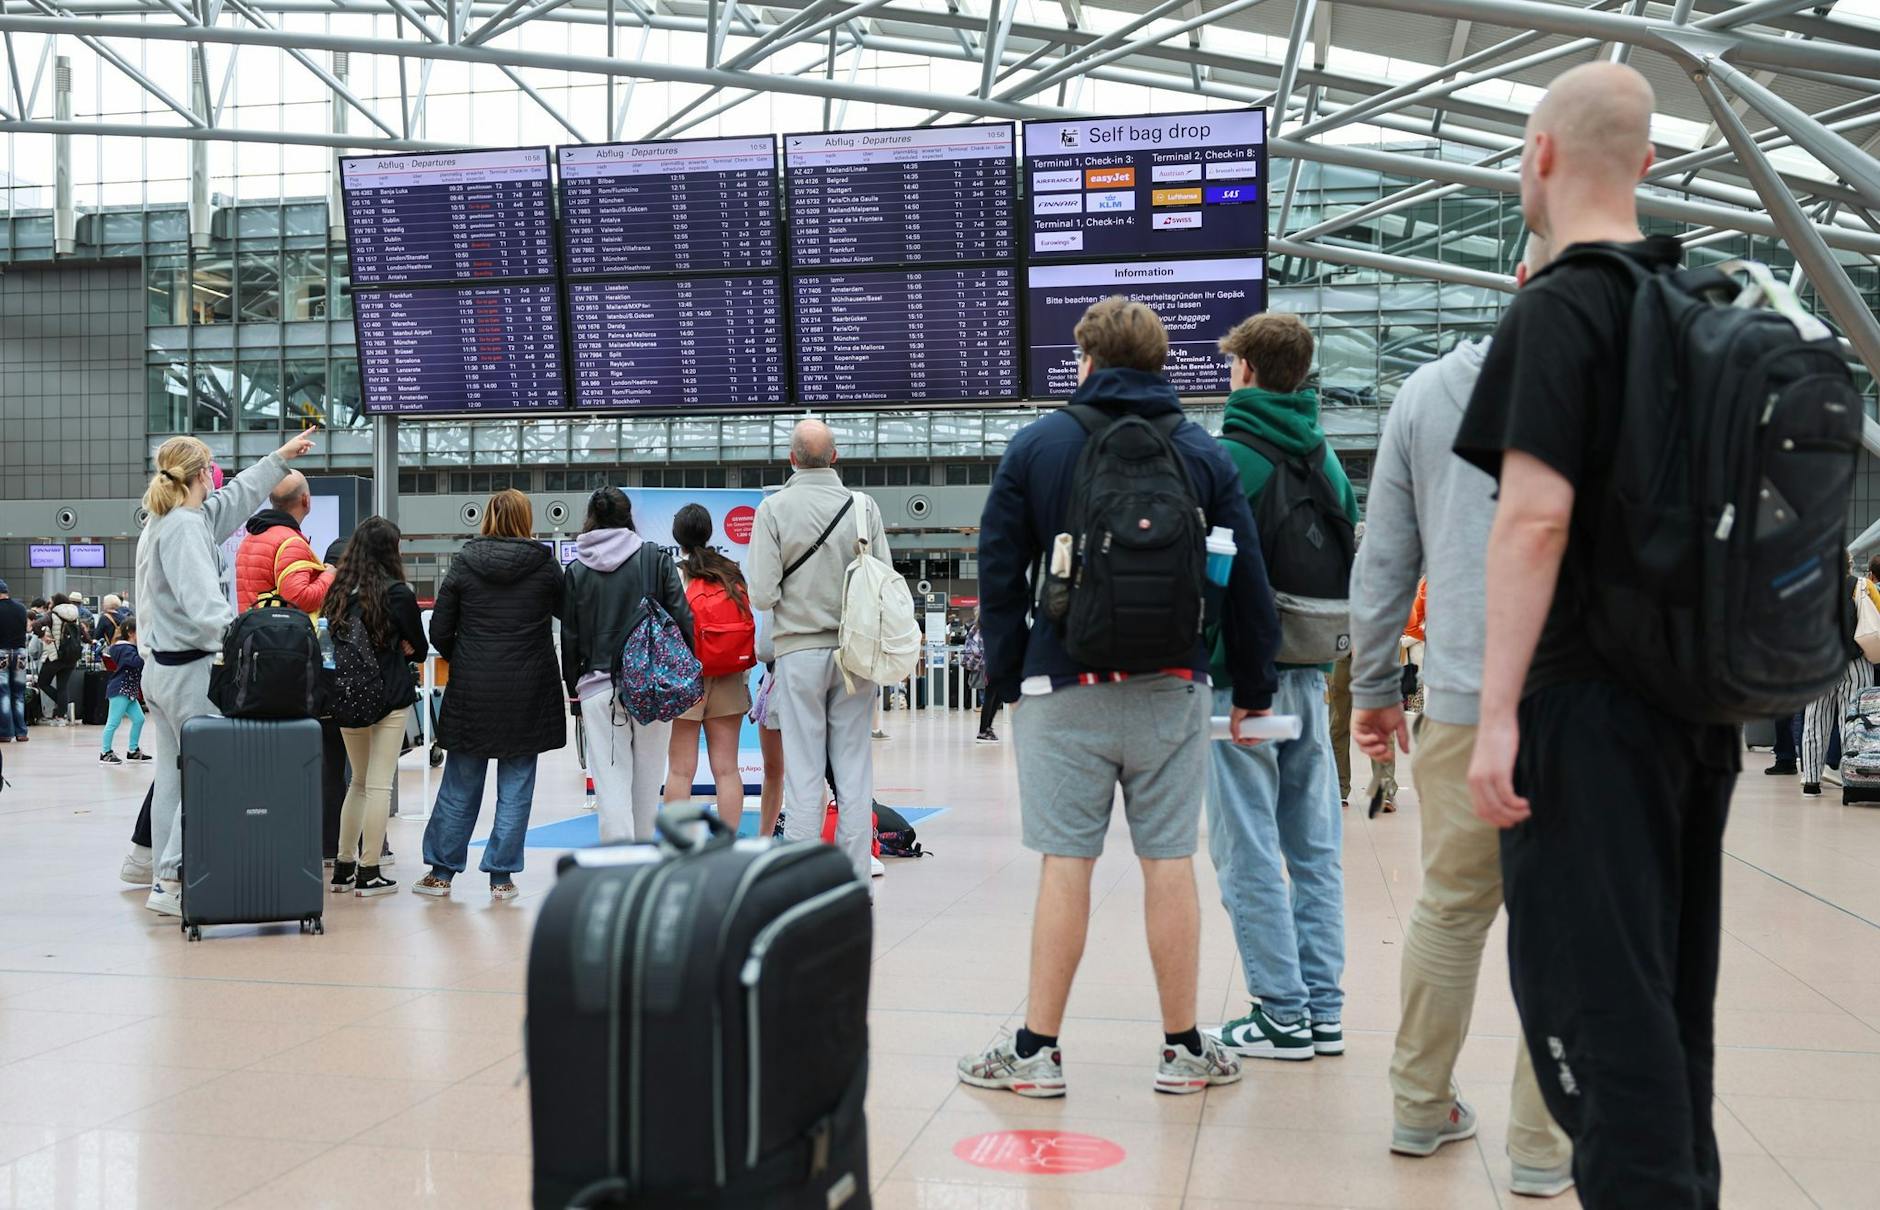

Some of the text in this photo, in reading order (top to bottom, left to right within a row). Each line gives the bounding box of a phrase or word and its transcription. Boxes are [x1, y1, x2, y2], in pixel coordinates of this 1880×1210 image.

[1089, 123, 1210, 143] Self bag drop
[825, 136, 912, 147] Abflug Departures
[596, 148, 678, 159] Abflug Departures
[1152, 148, 1255, 162] Terminal 2, Check-in 8:
[378, 159, 456, 170] Abflug Departures
[1033, 155, 1133, 168] Terminal 1, Check-in 3:
[1090, 173, 1130, 183] easyJet
[1222, 190, 1240, 198] SAS
[1035, 216, 1134, 229] Terminal 1, Check-in 4:
[1115, 267, 1173, 277] Information
[1064, 296, 1098, 304] beachten
[1130, 292, 1204, 302] Sicherheitsgründen
[1217, 290, 1245, 299] Gepäck
[1166, 300, 1175, 309] zu
[1178, 314, 1210, 323] baggage
[1166, 348, 1187, 356] ck-In
